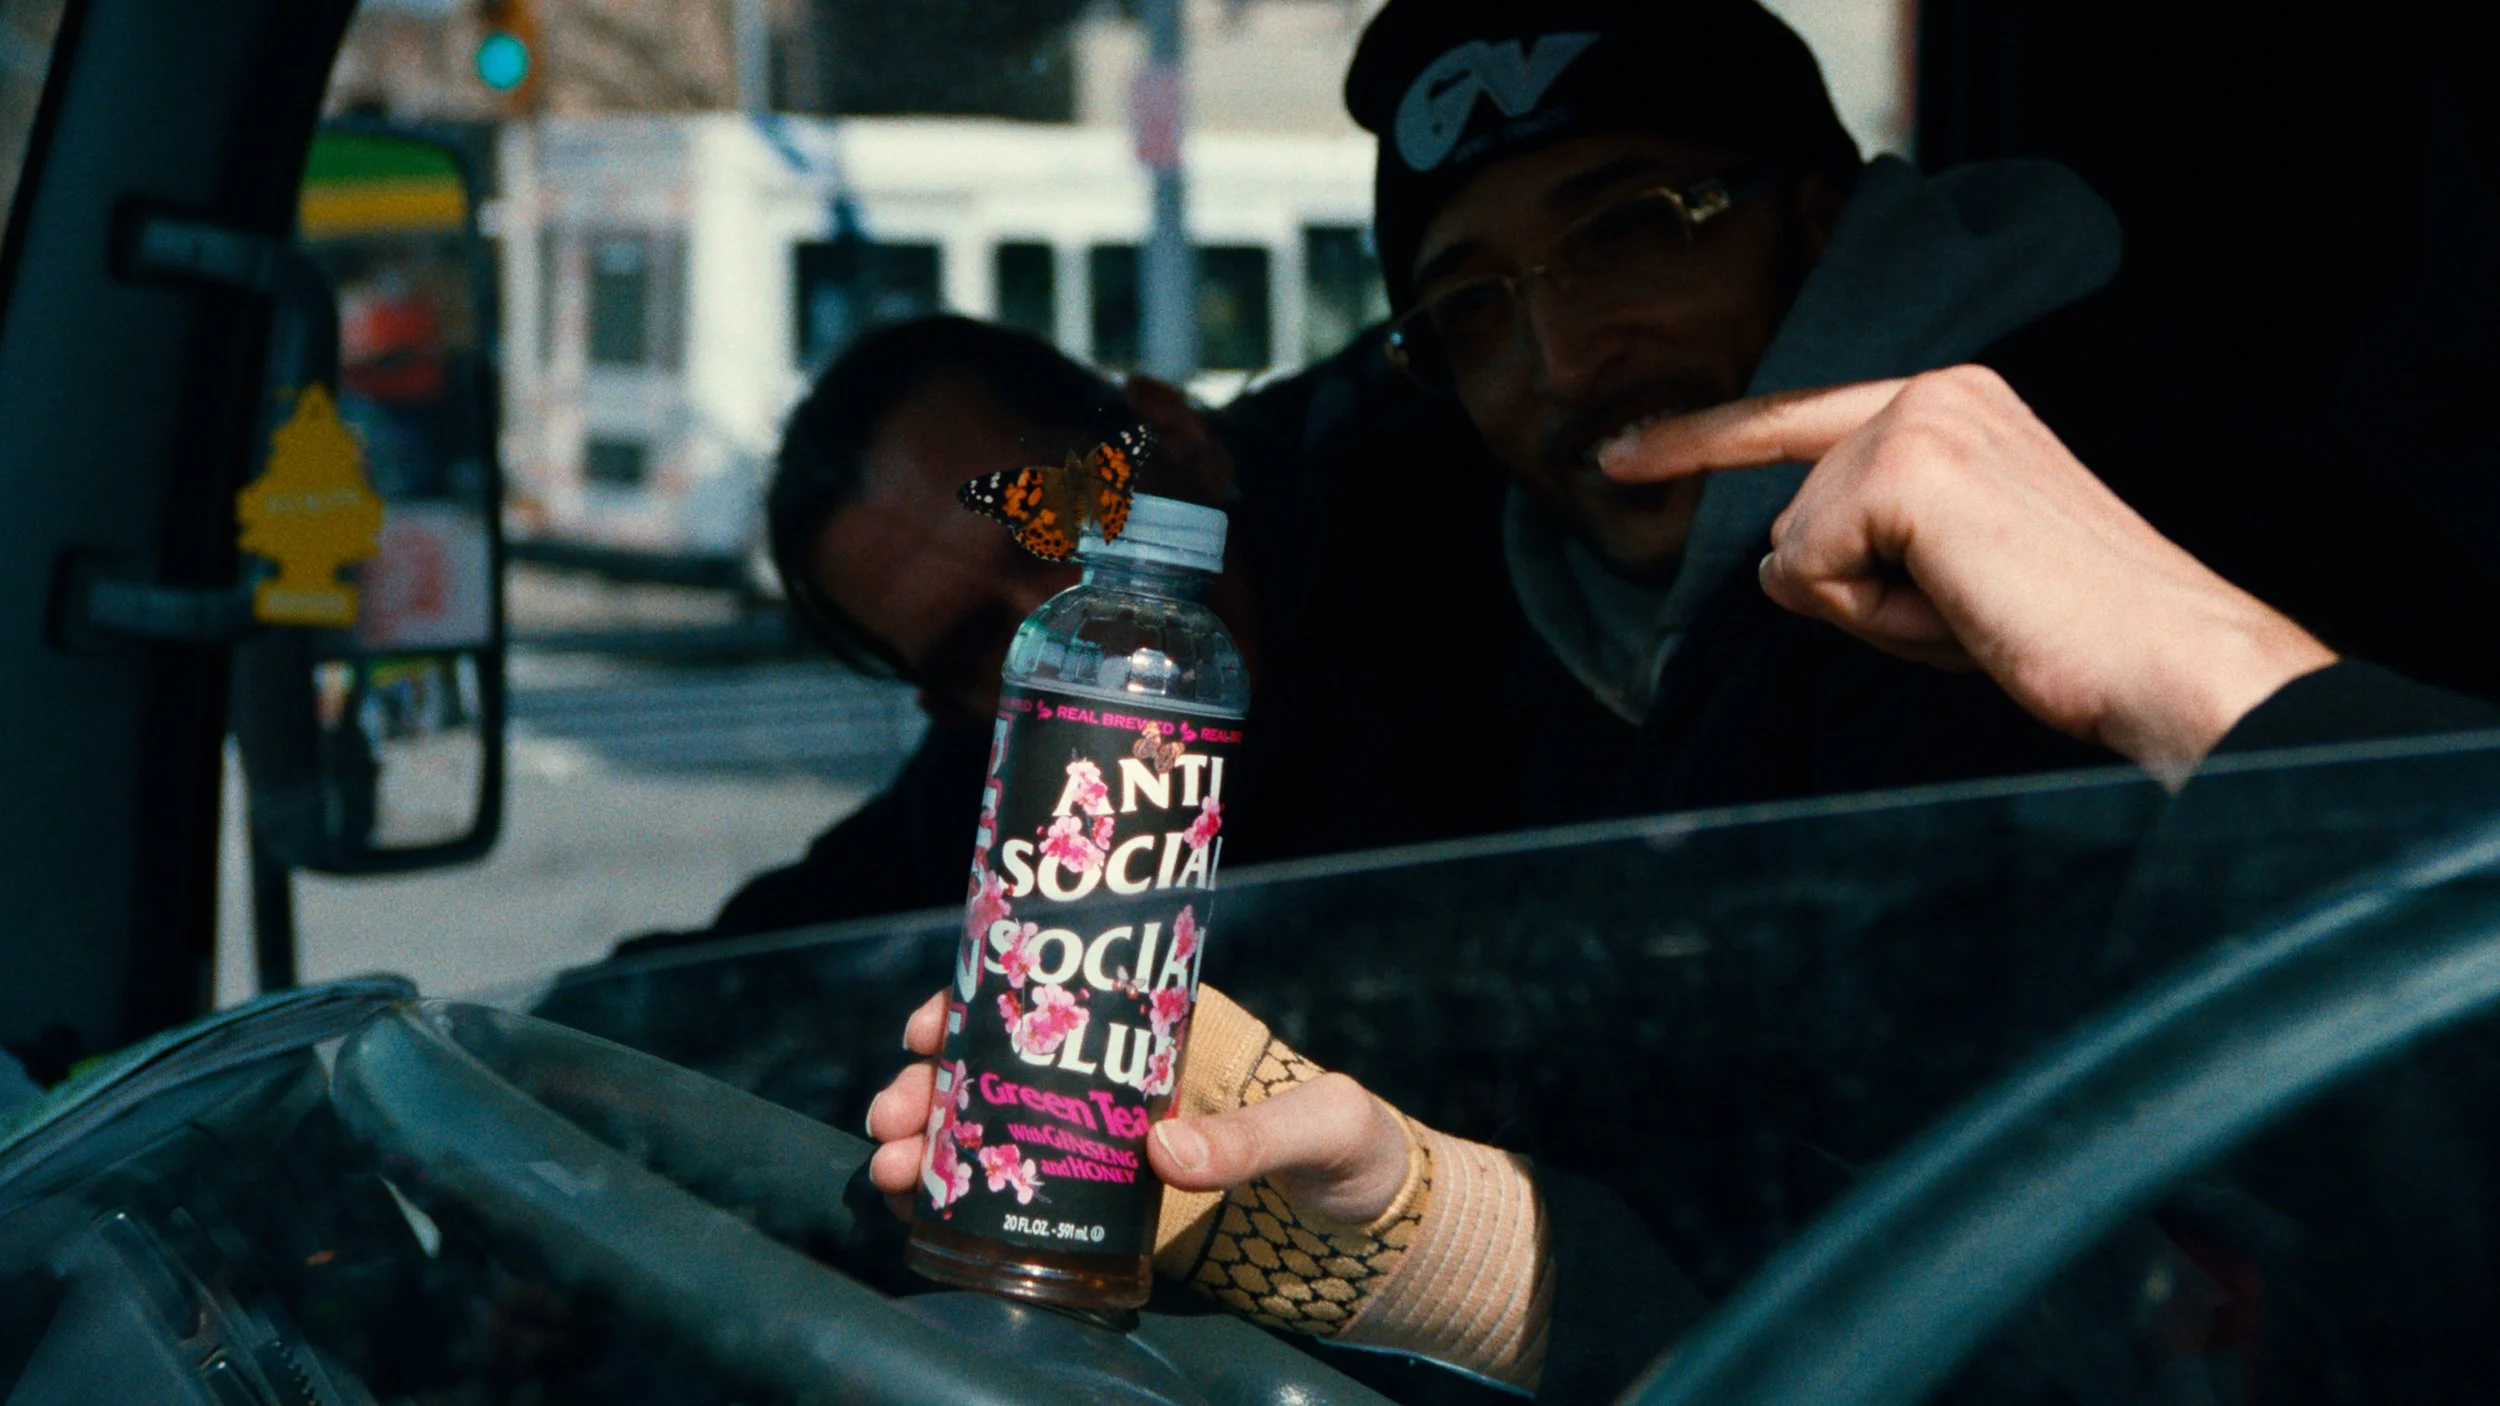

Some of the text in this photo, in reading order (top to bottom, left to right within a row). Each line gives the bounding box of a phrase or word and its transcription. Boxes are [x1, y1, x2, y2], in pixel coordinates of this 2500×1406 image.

[1056, 704, 1099, 724] REAL
[1102, 712, 1177, 736] BREWD
[1052, 754, 1224, 816] ANTI
[980, 1072, 1151, 1139] Green Tea
[1066, 1154, 1135, 1184] HONEY
[1003, 1214, 1017, 1231] 20
[1057, 1222, 1075, 1239] 591
